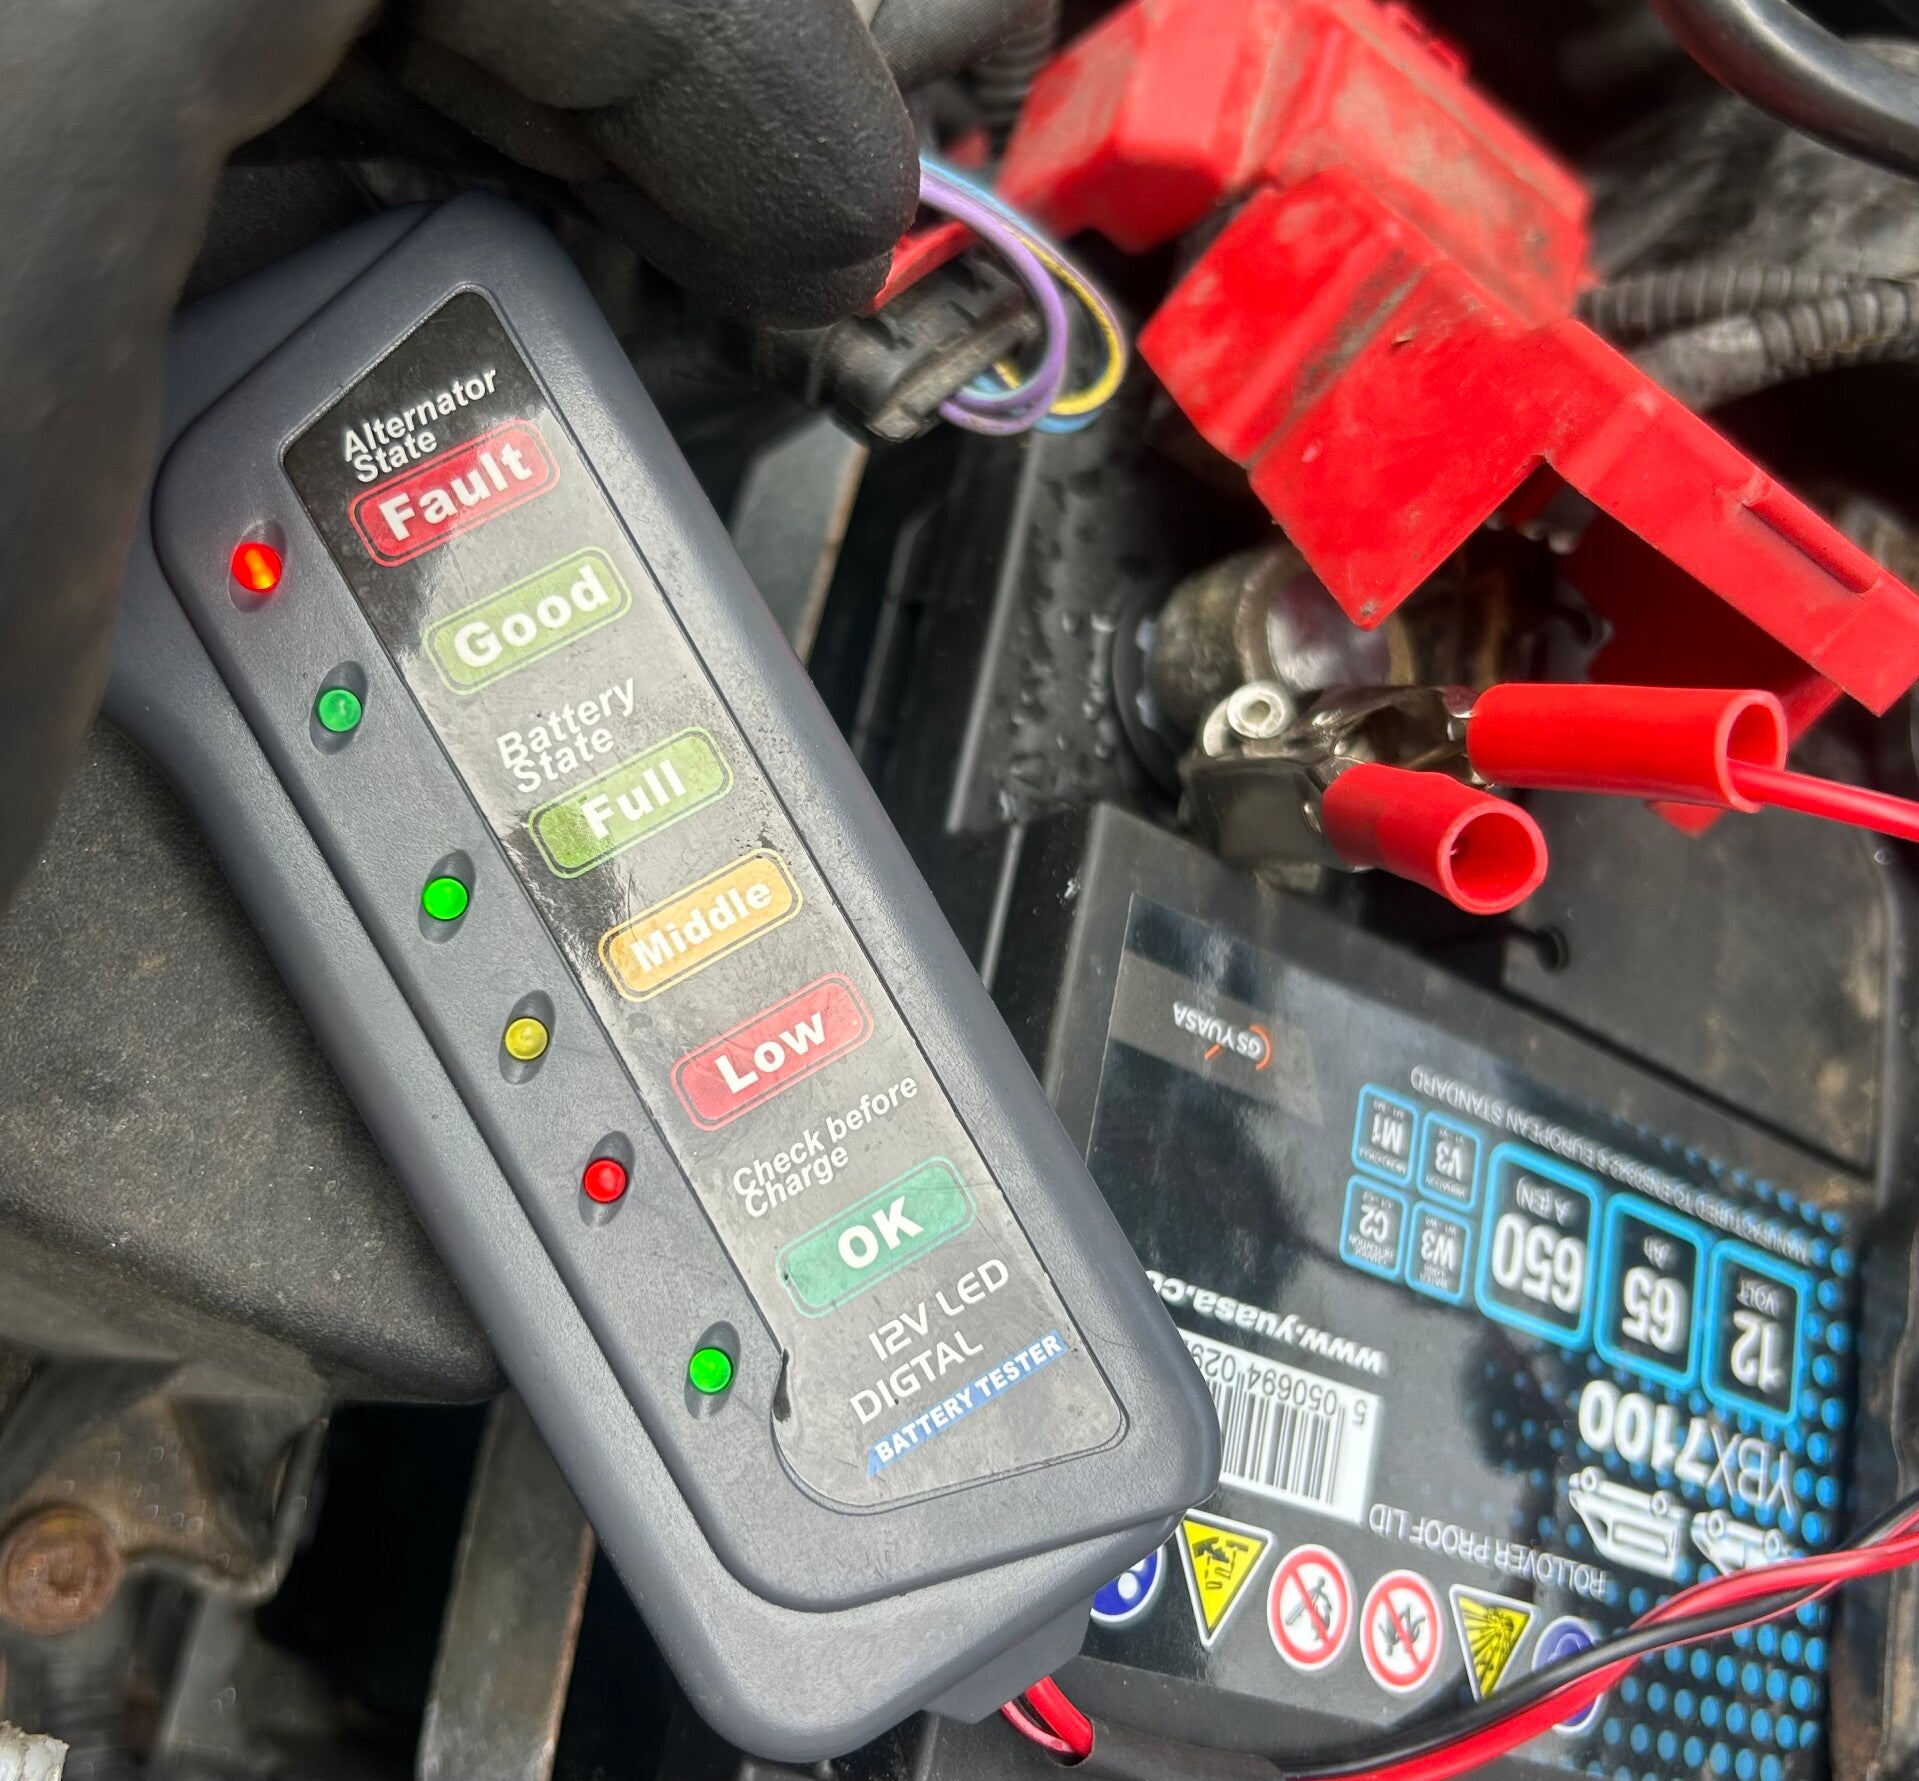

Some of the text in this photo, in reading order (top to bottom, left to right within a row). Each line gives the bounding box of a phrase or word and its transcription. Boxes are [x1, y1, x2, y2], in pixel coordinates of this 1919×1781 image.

[344, 369, 496, 462] Alternator
[352, 431, 438, 483] State
[378, 442, 533, 541] Fault
[454, 564, 610, 667] Good
[496, 677, 633, 769] Battery
[512, 728, 614, 793] State
[581, 760, 687, 839] Full
[630, 882, 772, 973] Middle
[714, 1011, 826, 1094] Low
[732, 1077, 918, 1196] Check before
[1371, 1114, 1402, 1155] M1
[1410, 1065, 1506, 1128] STANDARD
[1506, 1104, 1596, 1171] EUROPEAN
[744, 1146, 849, 1218] Charge
[1435, 1140, 1462, 1182] V3
[836, 1195, 924, 1269] OK
[1359, 1204, 1390, 1243] C2
[1420, 1228, 1456, 1271] W3
[1491, 1211, 1586, 1314] 650
[867, 1258, 1009, 1362] 12V LED
[1622, 1266, 1686, 1355] 65
[1736, 1276, 1781, 1319] VOLT
[849, 1330, 985, 1425] DIGTAL
[1246, 1361, 1338, 1417] 050694
[1729, 1309, 1785, 1395] 12
[874, 1333, 1063, 1464] BATTERY TESTER
[1351, 1399, 1368, 1427] 5
[1578, 1380, 1795, 1521] YBX7100
[1368, 1503, 1606, 1601] ROLLOVER PROOF LID
